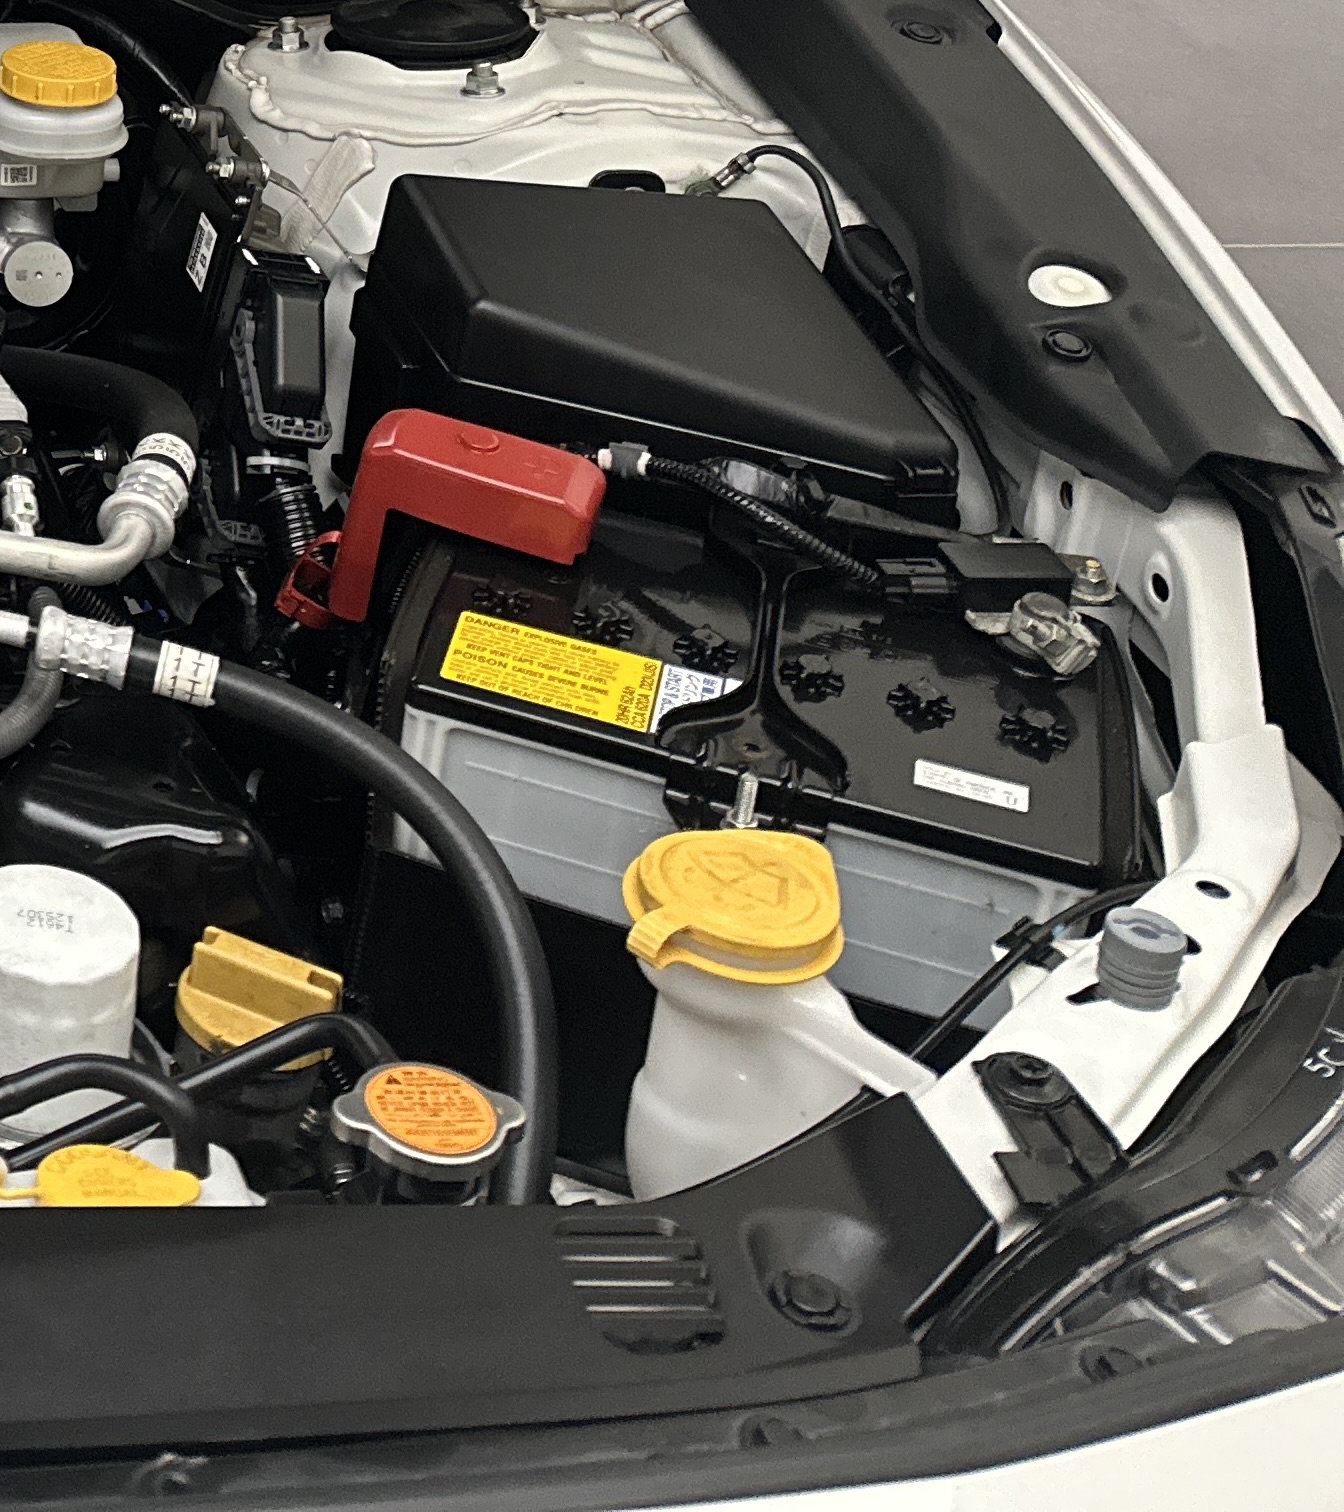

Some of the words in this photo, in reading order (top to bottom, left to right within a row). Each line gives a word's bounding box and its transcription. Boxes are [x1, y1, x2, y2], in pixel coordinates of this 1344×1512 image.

[464, 615, 521, 636] DANGER
[523, 631, 568, 647] EXPLOSIVE
[569, 643, 598, 655] GASES
[452, 649, 508, 669] POISON
[512, 655, 535, 666] CAPS
[563, 668, 581, 678] AND
[664, 668, 683, 693] START
[1303, 1028, 1344, 1078] 5C
